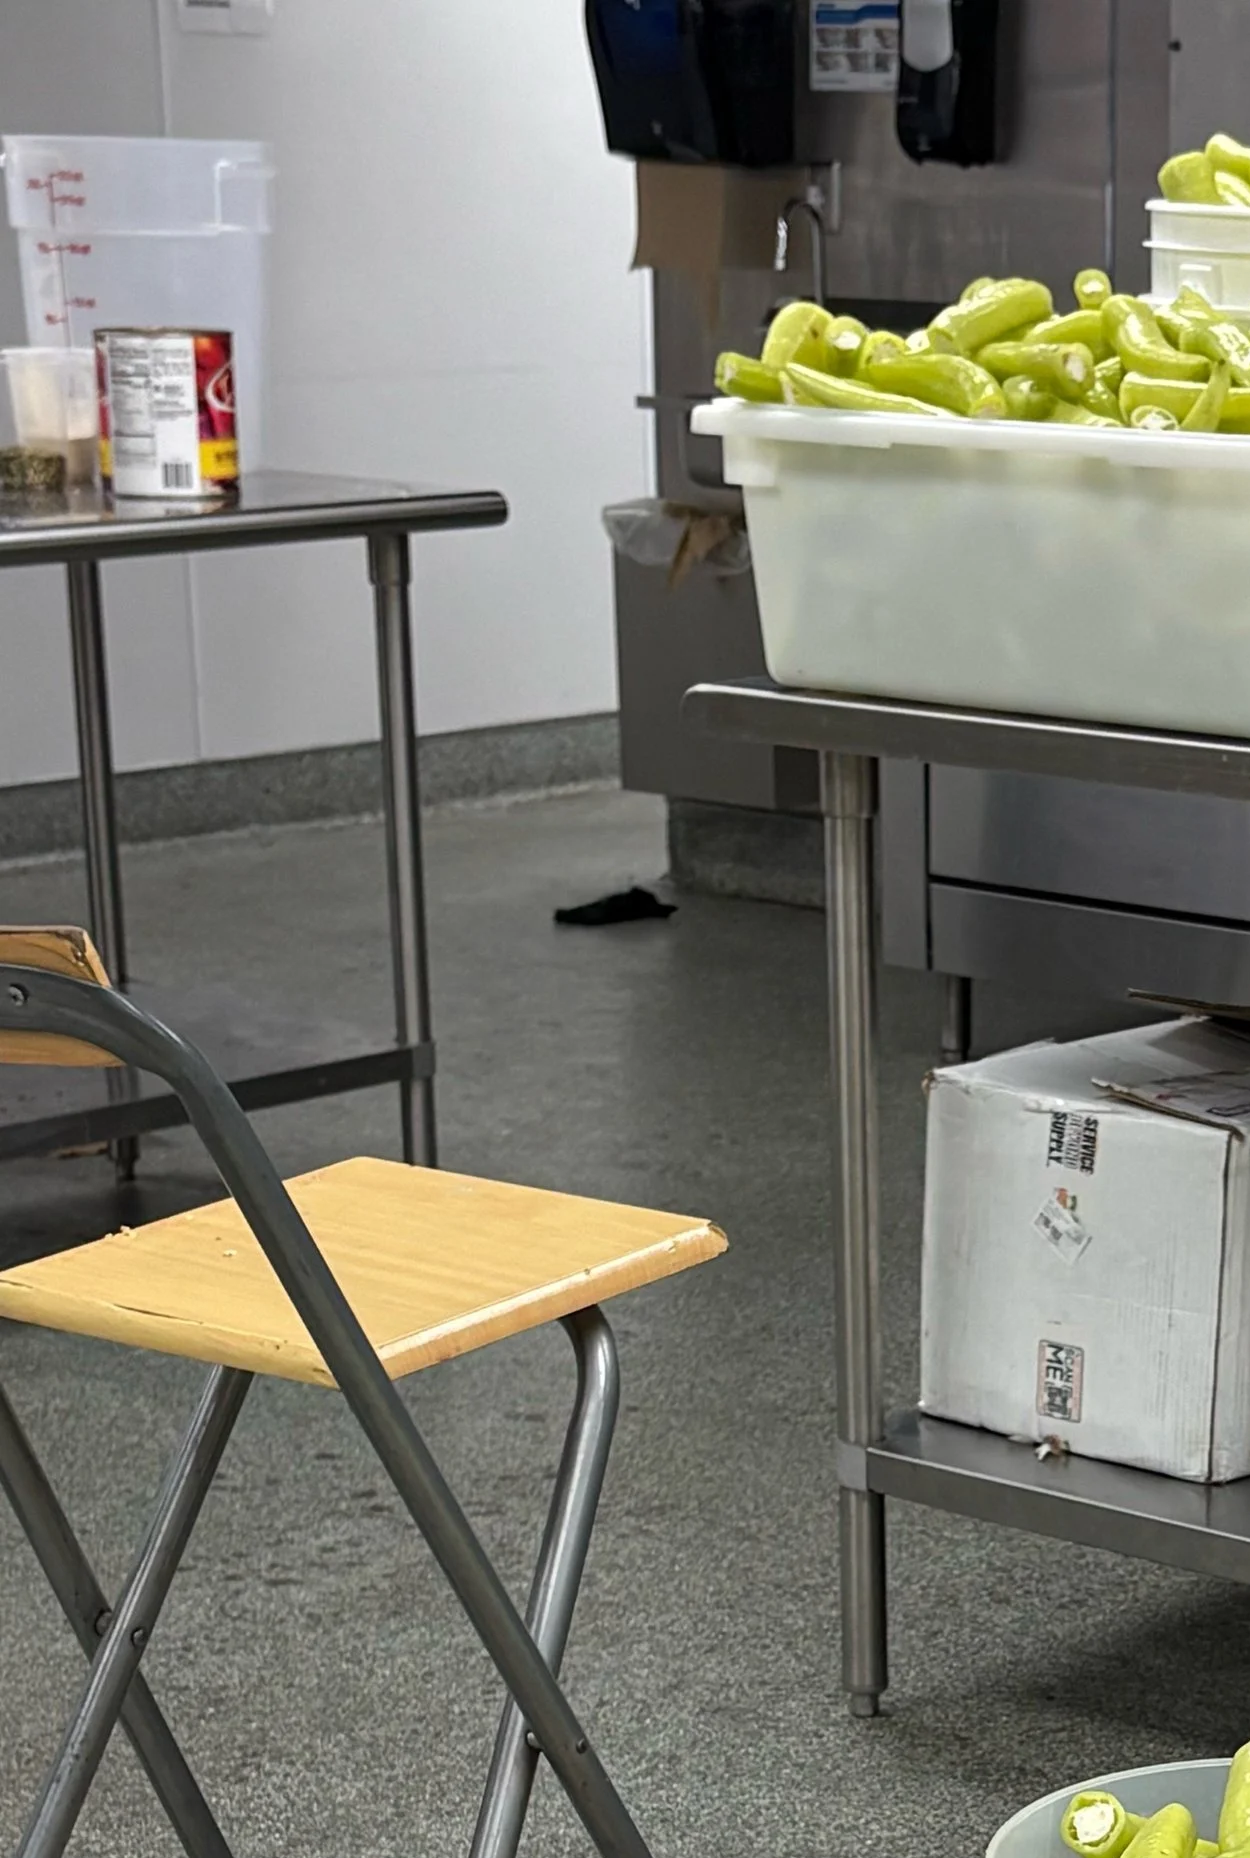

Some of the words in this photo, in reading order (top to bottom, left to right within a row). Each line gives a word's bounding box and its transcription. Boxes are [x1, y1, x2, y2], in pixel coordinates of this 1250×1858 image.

[1048, 1111, 1067, 1165] SUPPLY
[1080, 1116, 1099, 1176] SERVICE
[1046, 1343, 1064, 1381] ME
